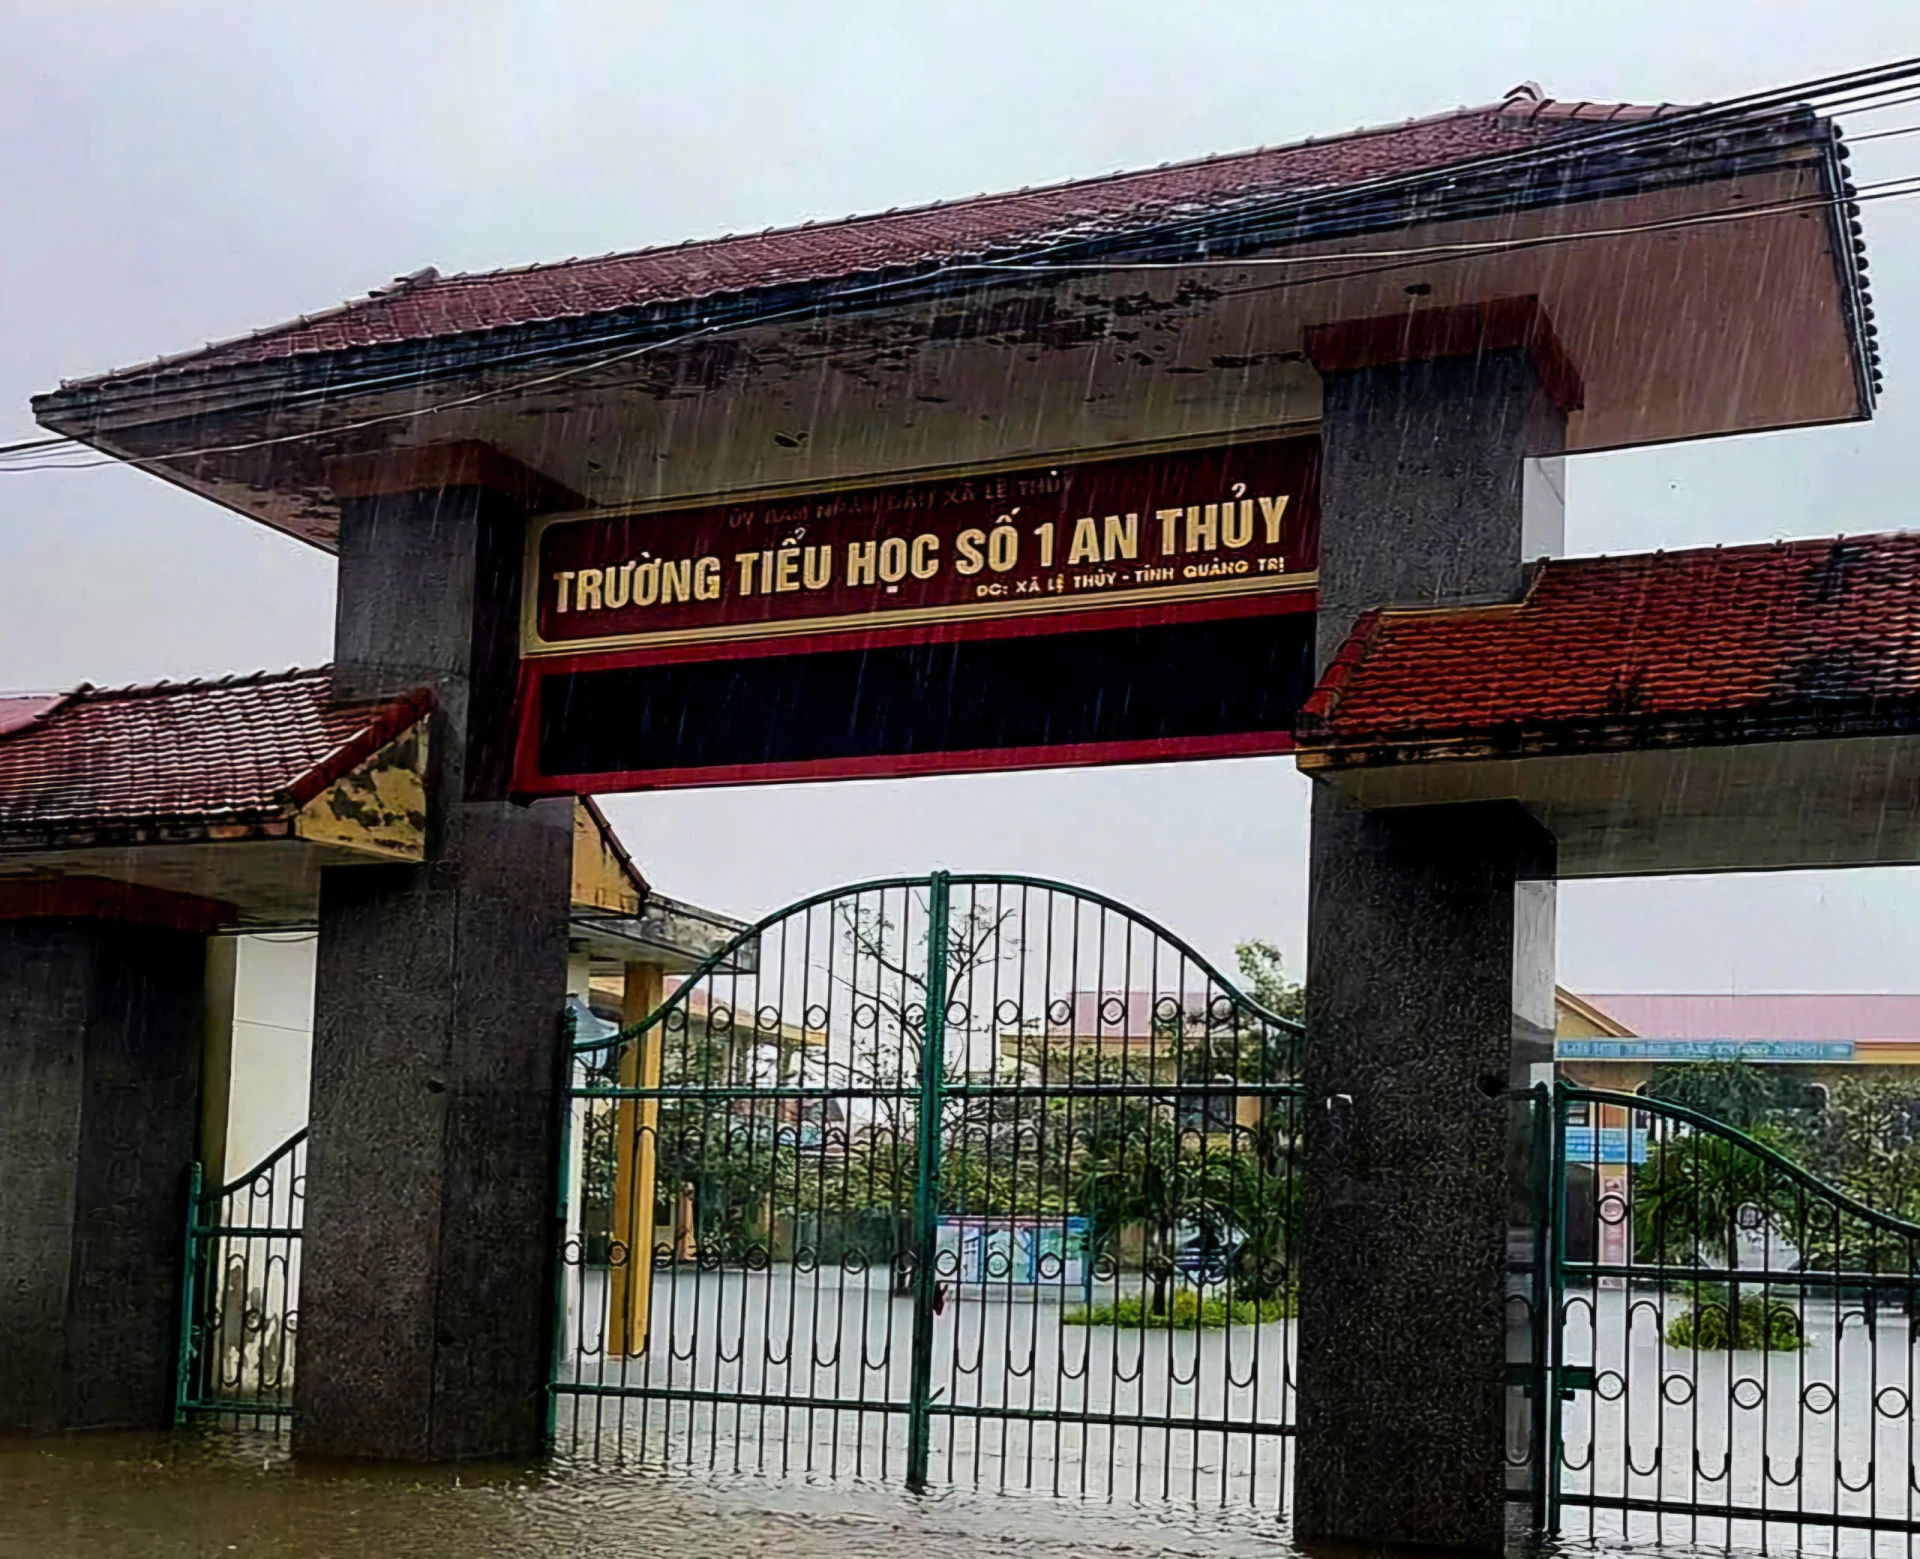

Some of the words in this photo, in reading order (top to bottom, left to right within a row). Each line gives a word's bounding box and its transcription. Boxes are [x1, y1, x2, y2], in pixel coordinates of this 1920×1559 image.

[553, 551, 721, 613] TRƯỜNG
[735, 527, 833, 596] TIỂU
[846, 533, 940, 594] HỌC
[955, 506, 1021, 575] SỐ
[1033, 522, 1054, 568] 1
[1068, 512, 1139, 566] AN
[1156, 482, 1290, 556] THỦY
[1015, 576, 1040, 593] XÃ
[1047, 573, 1065, 594] LỆ
[1073, 569, 1117, 588] THỦY
[1183, 557, 1249, 578] QUẢNG
[1257, 556, 1285, 573] TRỊ
